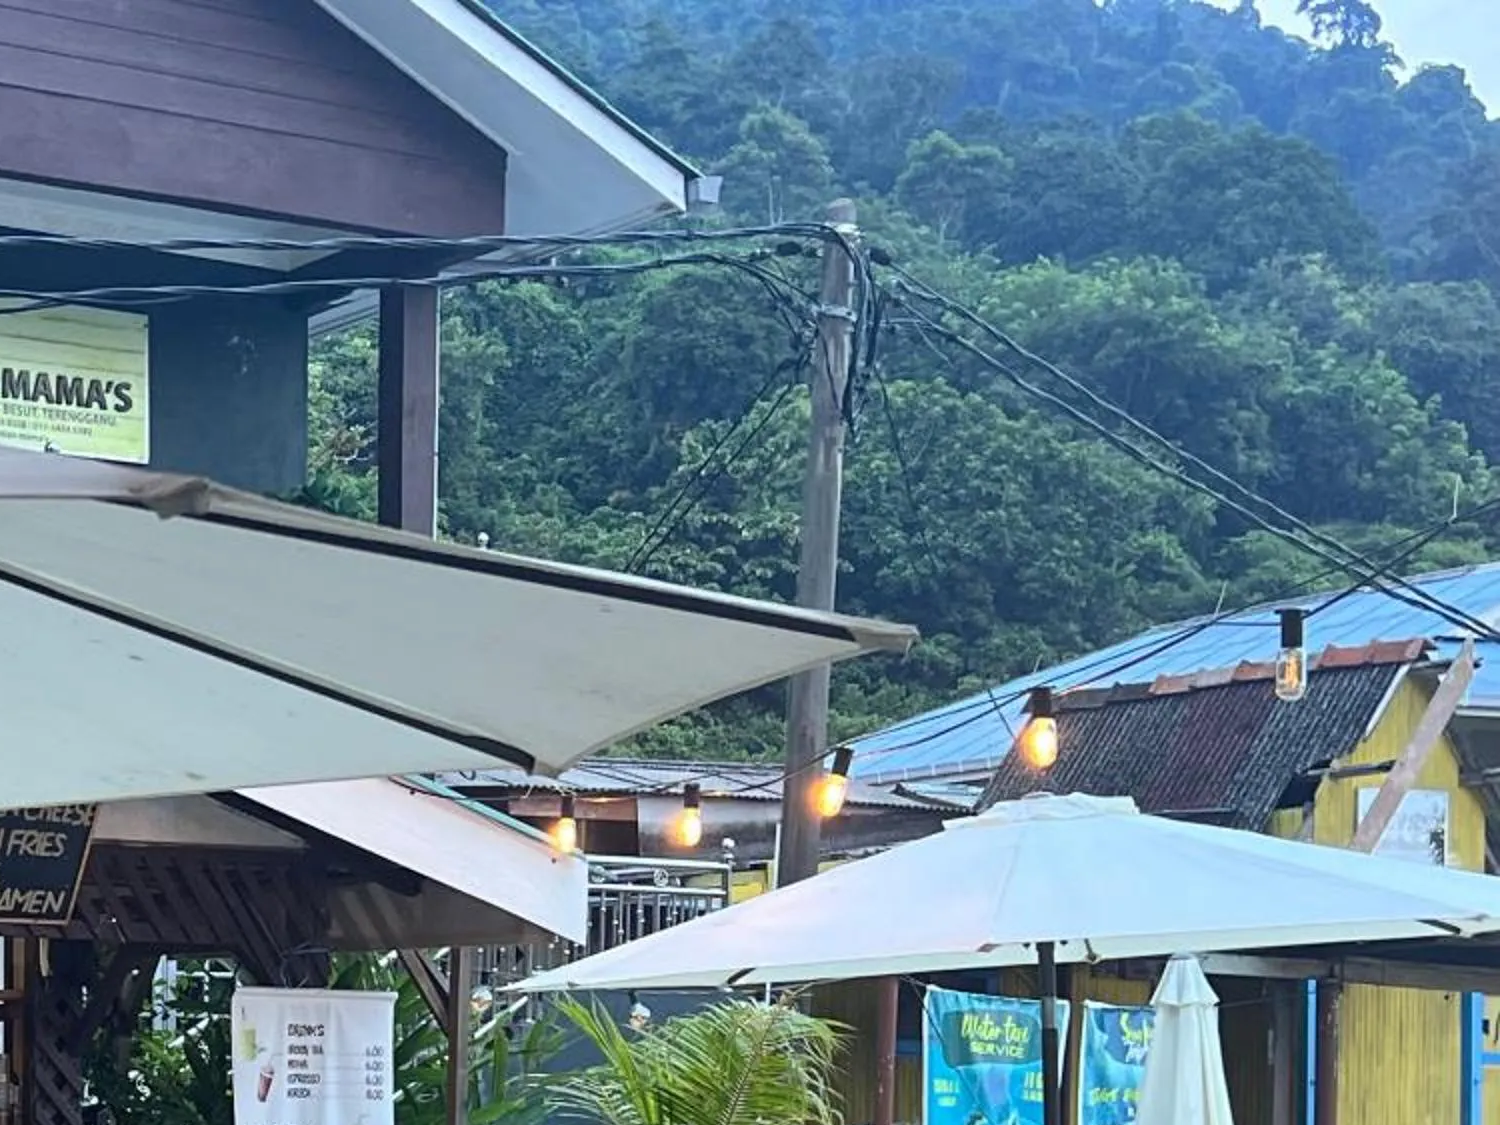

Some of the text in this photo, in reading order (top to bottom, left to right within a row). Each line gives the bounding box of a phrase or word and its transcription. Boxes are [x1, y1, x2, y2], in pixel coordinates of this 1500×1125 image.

[2, 366, 133, 413] MAMA'S
[6, 829, 67, 858] FRIES
[287, 1023, 325, 1037] DRINKS
[970, 1041, 1025, 1058] SERVICE
